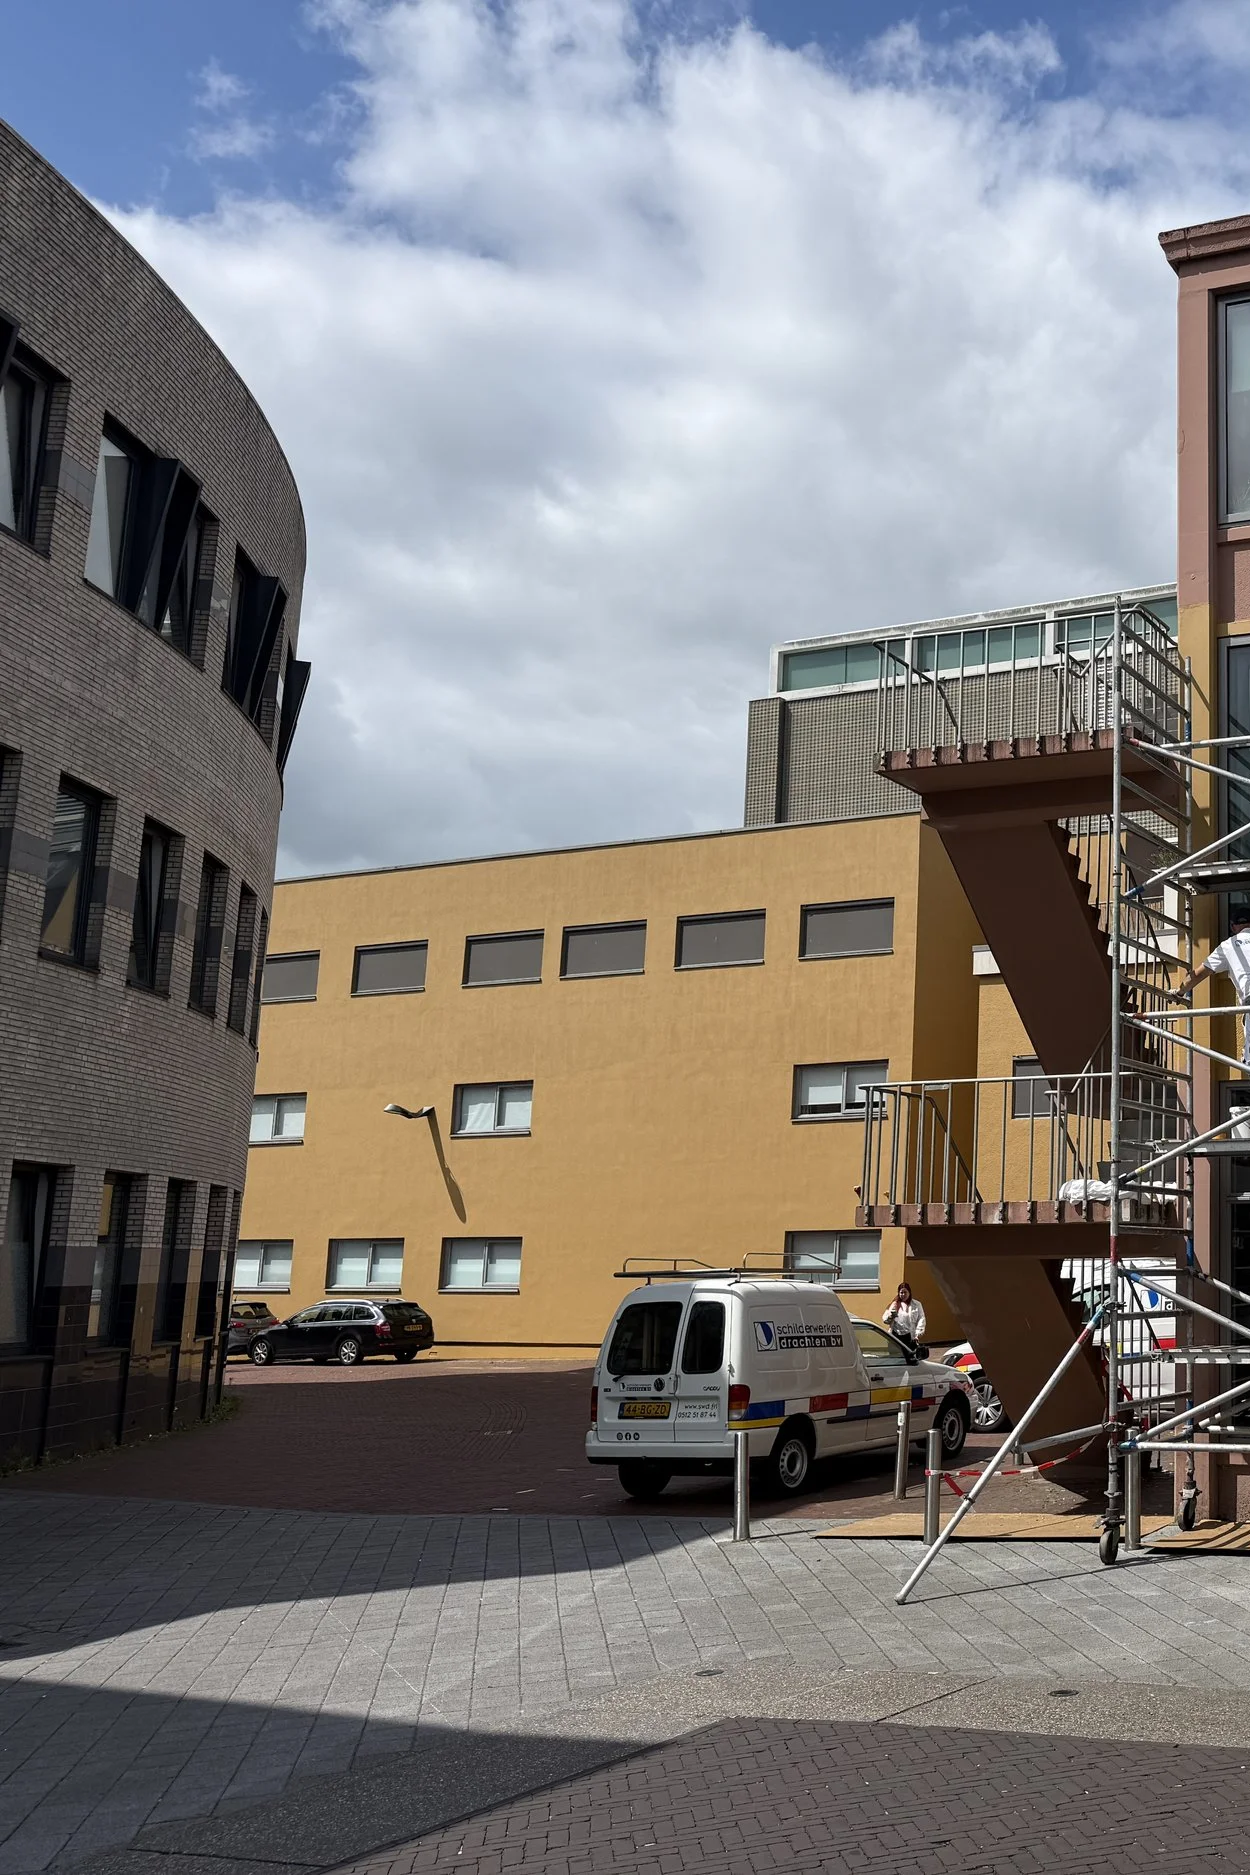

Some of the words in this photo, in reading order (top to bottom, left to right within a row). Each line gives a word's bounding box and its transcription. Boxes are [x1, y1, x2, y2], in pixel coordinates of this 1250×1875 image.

[776, 1323, 842, 1335] schilderwerken
[780, 1336, 827, 1348] drachten
[830, 1336, 842, 1346] bv
[677, 1411, 692, 1419] 0512
[692, 1411, 699, 1419] 51
